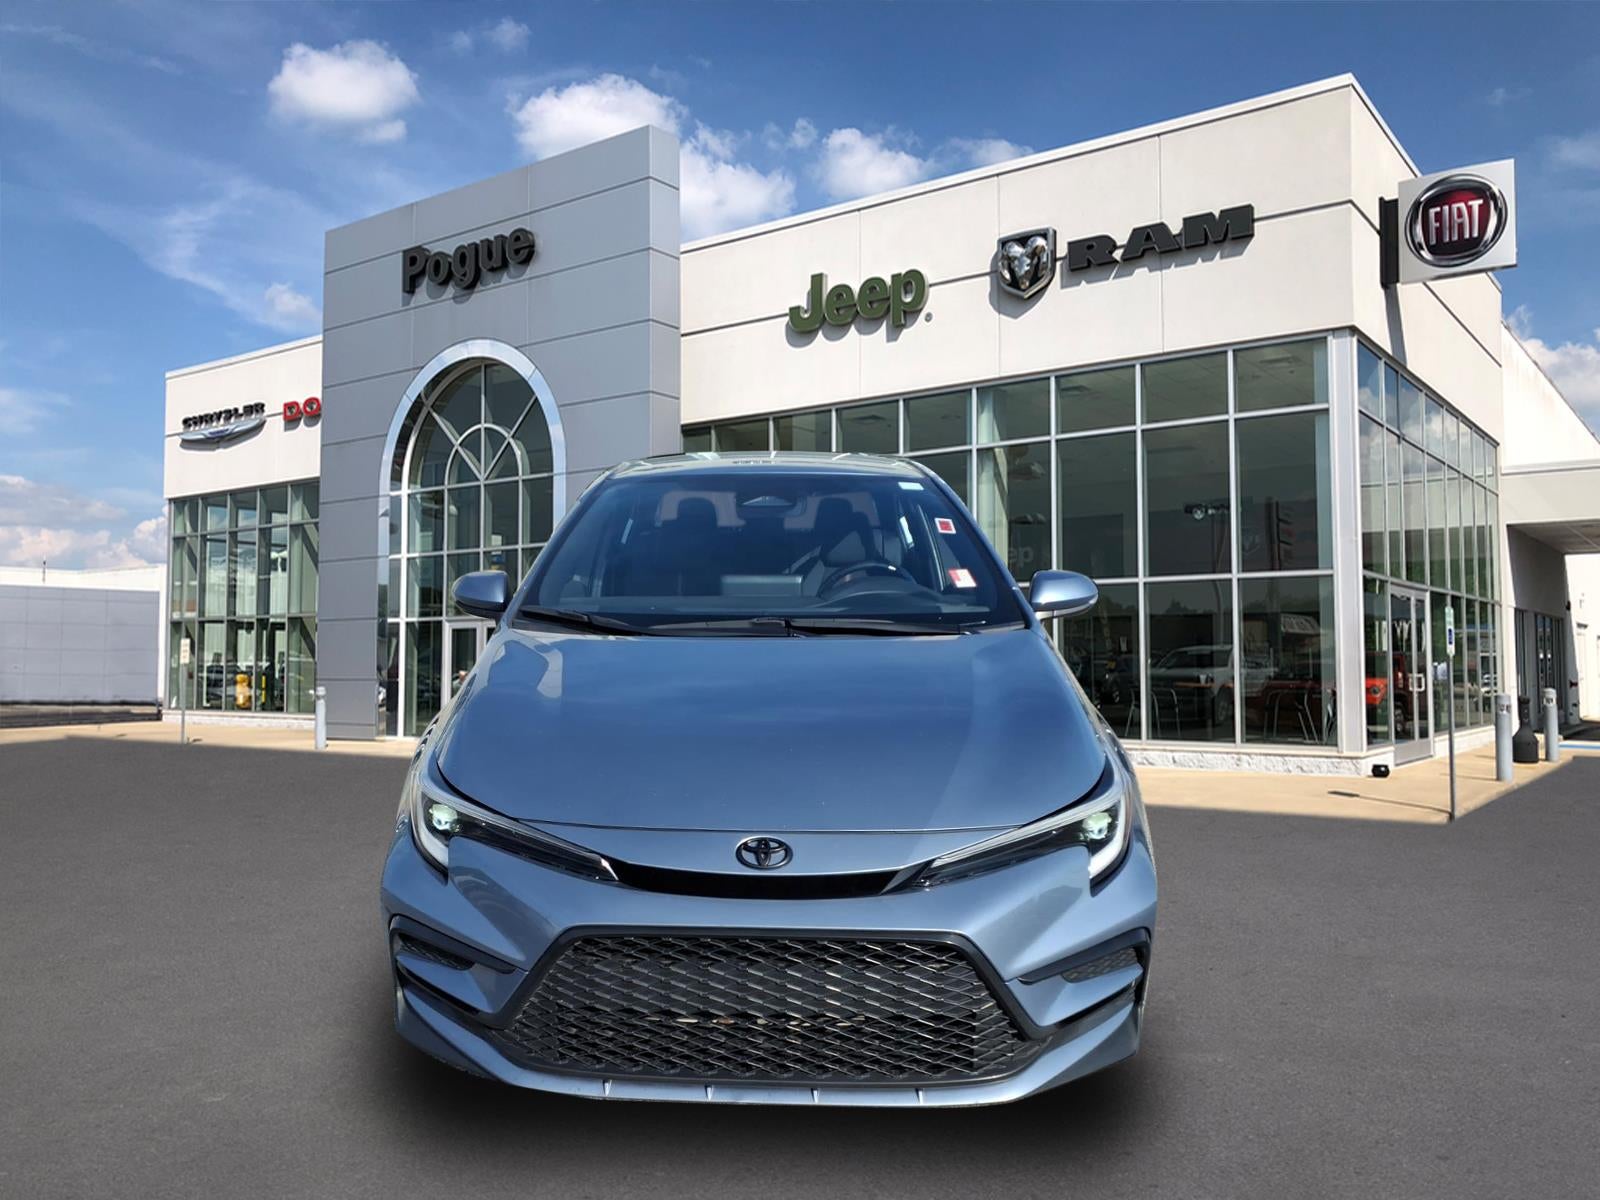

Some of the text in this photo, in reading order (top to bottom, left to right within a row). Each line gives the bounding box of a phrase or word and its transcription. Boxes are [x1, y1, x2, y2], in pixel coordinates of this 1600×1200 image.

[1067, 203, 1255, 272] RAM
[1428, 199, 1484, 246] FIAT
[401, 227, 535, 294] Pogue
[788, 268, 929, 332] Jeep
[182, 402, 266, 428] CHRYSLER
